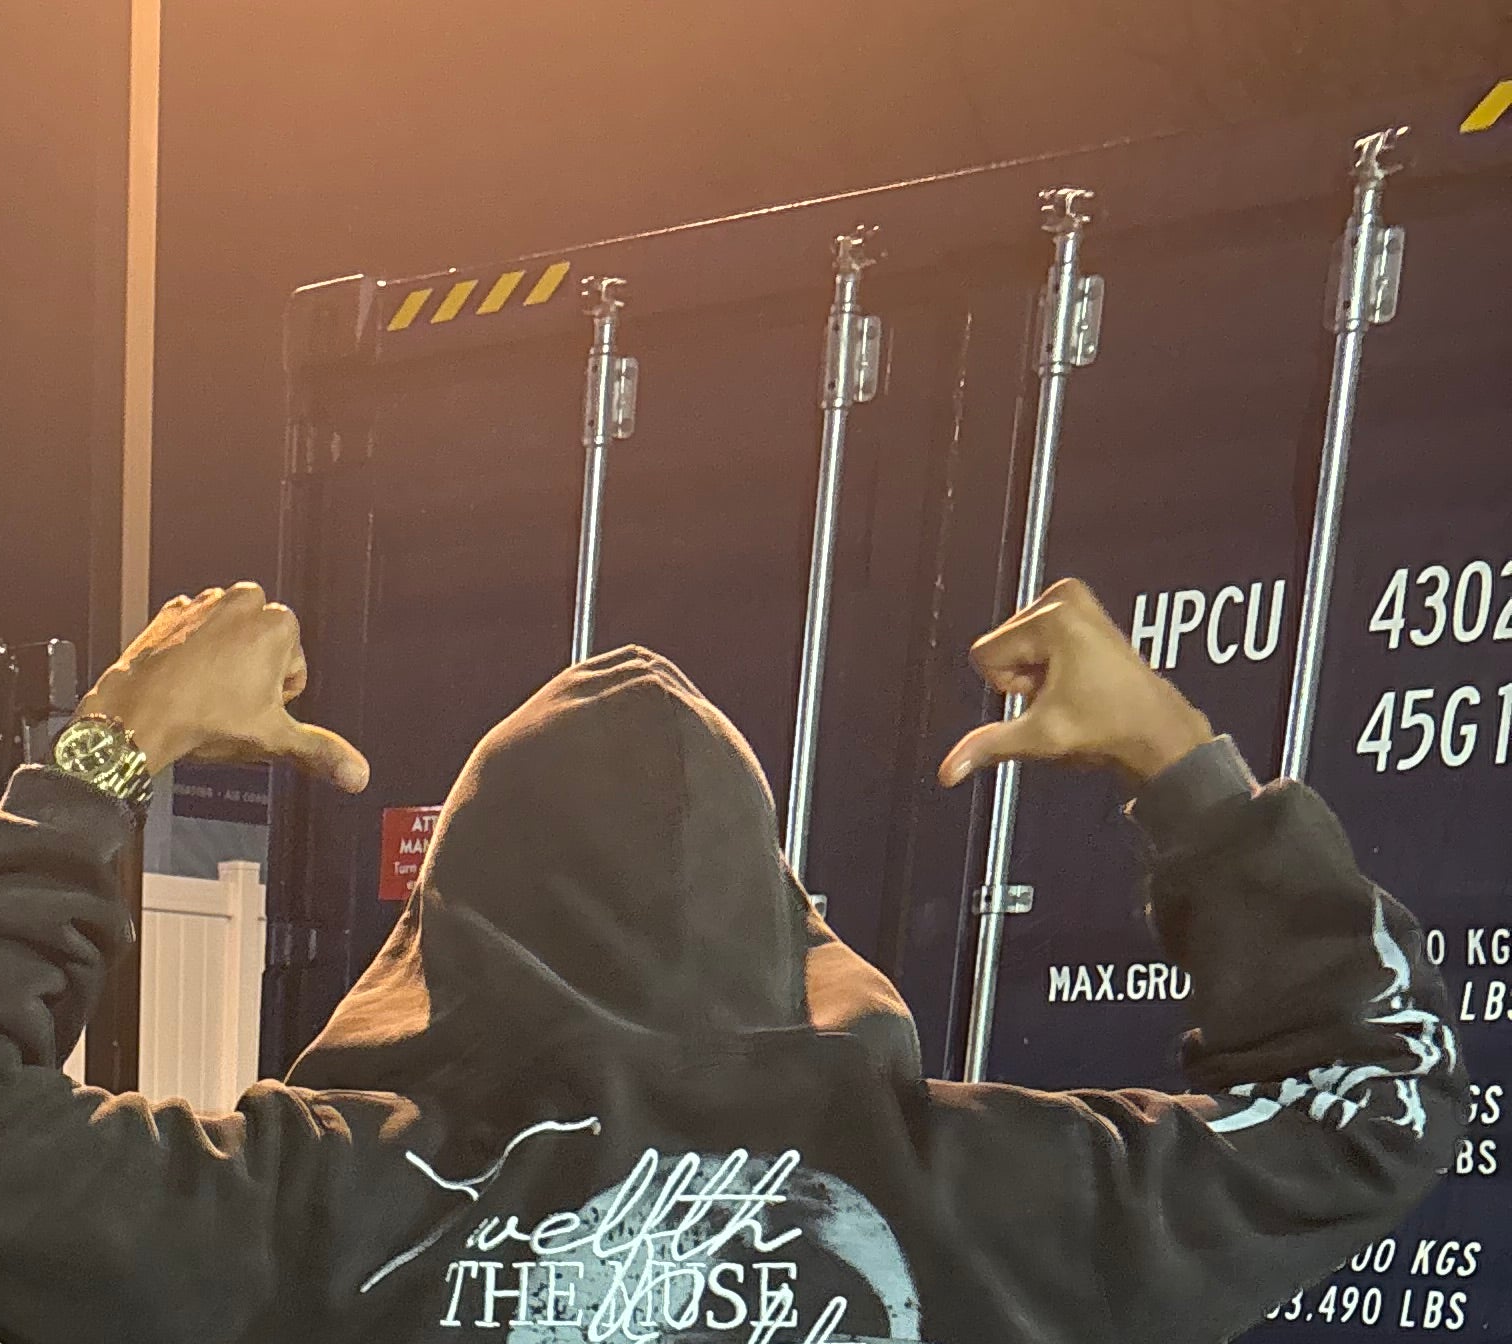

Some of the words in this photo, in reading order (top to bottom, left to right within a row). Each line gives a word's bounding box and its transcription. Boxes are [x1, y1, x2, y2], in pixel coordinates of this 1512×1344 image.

[1131, 579, 1286, 670] HPCU
[411, 814, 440, 833] ATT
[1467, 928, 1511, 966] KG
[1459, 981, 1512, 1021] LB
[1452, 1139, 1498, 1175] BS
[1410, 1239, 1482, 1277] KGS
[439, 1259, 584, 1328] THE
[1399, 1288, 1468, 1330] LBS
